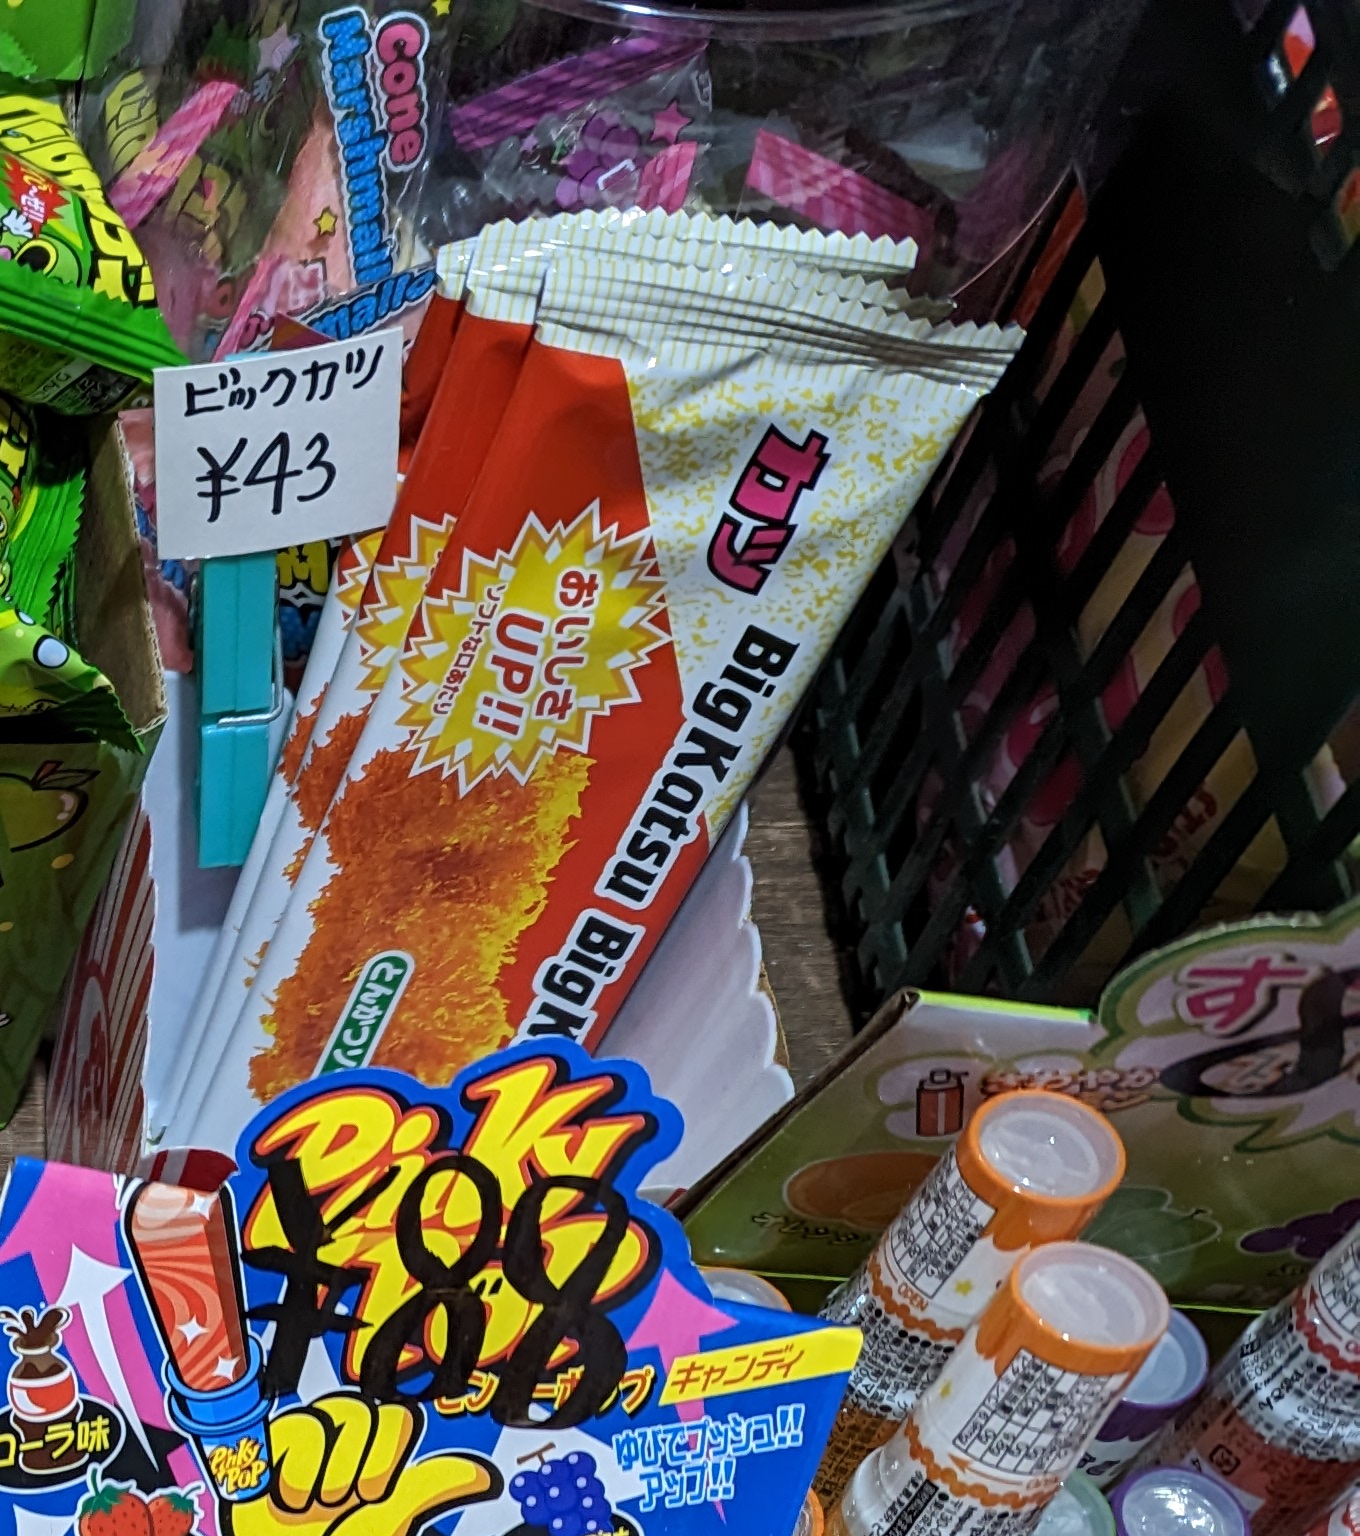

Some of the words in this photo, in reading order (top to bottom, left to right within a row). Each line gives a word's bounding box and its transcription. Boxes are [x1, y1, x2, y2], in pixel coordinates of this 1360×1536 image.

[183, 344, 385, 417] ビックカツ
[194, 431, 338, 523] ¥43
[707, 426, 831, 596] カツ
[475, 611, 547, 738] UP!!
[535, 569, 599, 721] おいしさ
[671, 1344, 806, 1392] キャンディ
[613, 1404, 805, 1474] ゆびでプッシュ!!
[640, 1459, 735, 1512] アップ!!
